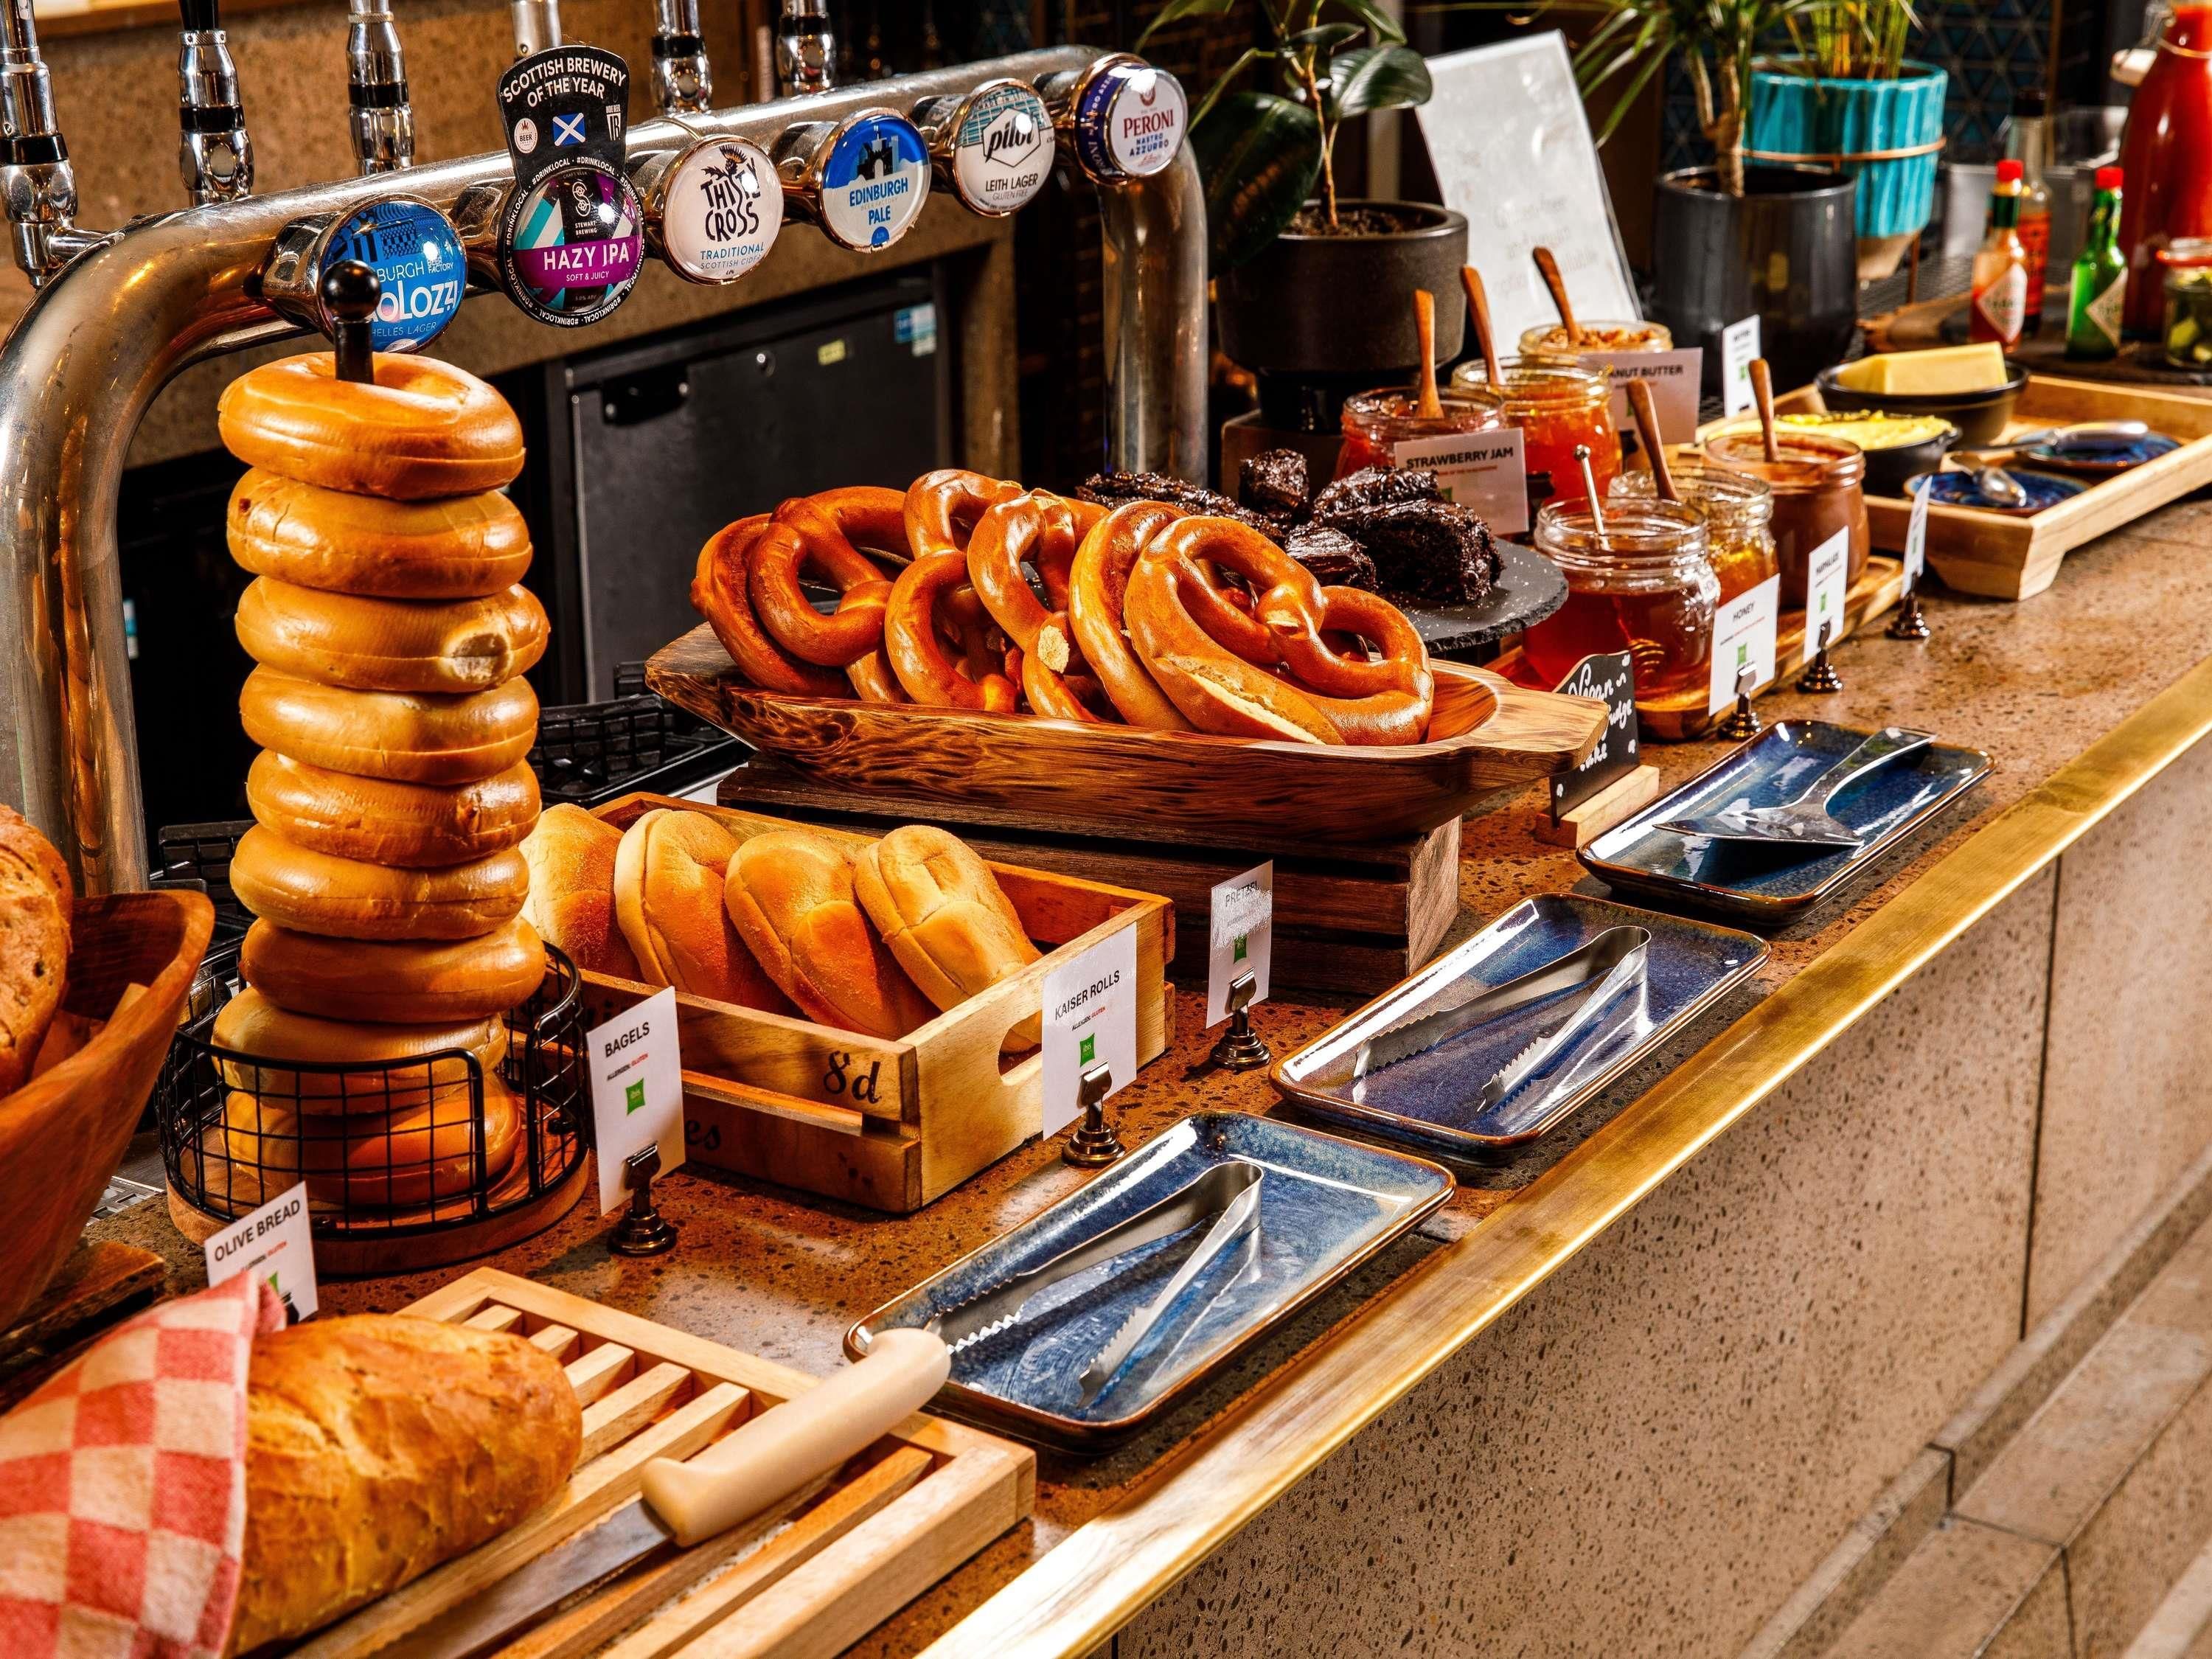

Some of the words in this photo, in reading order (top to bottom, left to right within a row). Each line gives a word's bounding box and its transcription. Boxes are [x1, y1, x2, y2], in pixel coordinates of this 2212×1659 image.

[503, 58, 564, 103] SCOTTISH
[567, 58, 627, 87] BREWERY
[527, 86, 543, 108] OF
[545, 77, 570, 97] THE
[572, 77, 605, 100] YEAR
[1123, 108, 1175, 139] PERONI
[519, 133, 532, 142] BEER
[1136, 133, 1164, 145] NASTRO
[1130, 139, 1169, 157] AZZURRO
[532, 157, 571, 185] #DRINKLOCAL
[577, 156, 615, 176] #DRINKLOCAL
[849, 177, 908, 206] EDINBURGH
[985, 178, 1009, 192] LEITH
[1011, 173, 1039, 189] LAGER
[706, 201, 759, 242] CROSS
[869, 205, 891, 225] PALE
[544, 246, 597, 271] HAZY
[700, 242, 765, 260] TRADITIONAL
[378, 261, 425, 283] BURGH
[428, 262, 454, 274] FACTORY
[700, 260, 738, 269] SCOTTISH
[566, 274, 583, 282] SOFT
[591, 271, 610, 279] JUICY
[539, 309, 579, 325] #DRINKLOCAL
[584, 296, 621, 324] #DRINKLOCAL
[408, 321, 437, 335] LAGER
[1641, 364, 1683, 378] BUTTER
[1406, 450, 1488, 469] STRAWBERRY
[1490, 447, 1514, 459] JAM
[1733, 602, 1756, 622] HONEY
[1608, 699, 1632, 729] udge
[1055, 988, 1088, 1020] KAISER
[1090, 970, 1120, 998] ROLLS
[1091, 1006, 1106, 1018] GLUTEN
[605, 1021, 650, 1058] BAGELS
[630, 1051, 649, 1067] GLUTEN
[823, 1049, 883, 1105] 8d
[214, 1226, 254, 1262] OLIVE
[257, 1200, 300, 1237] BREAD
